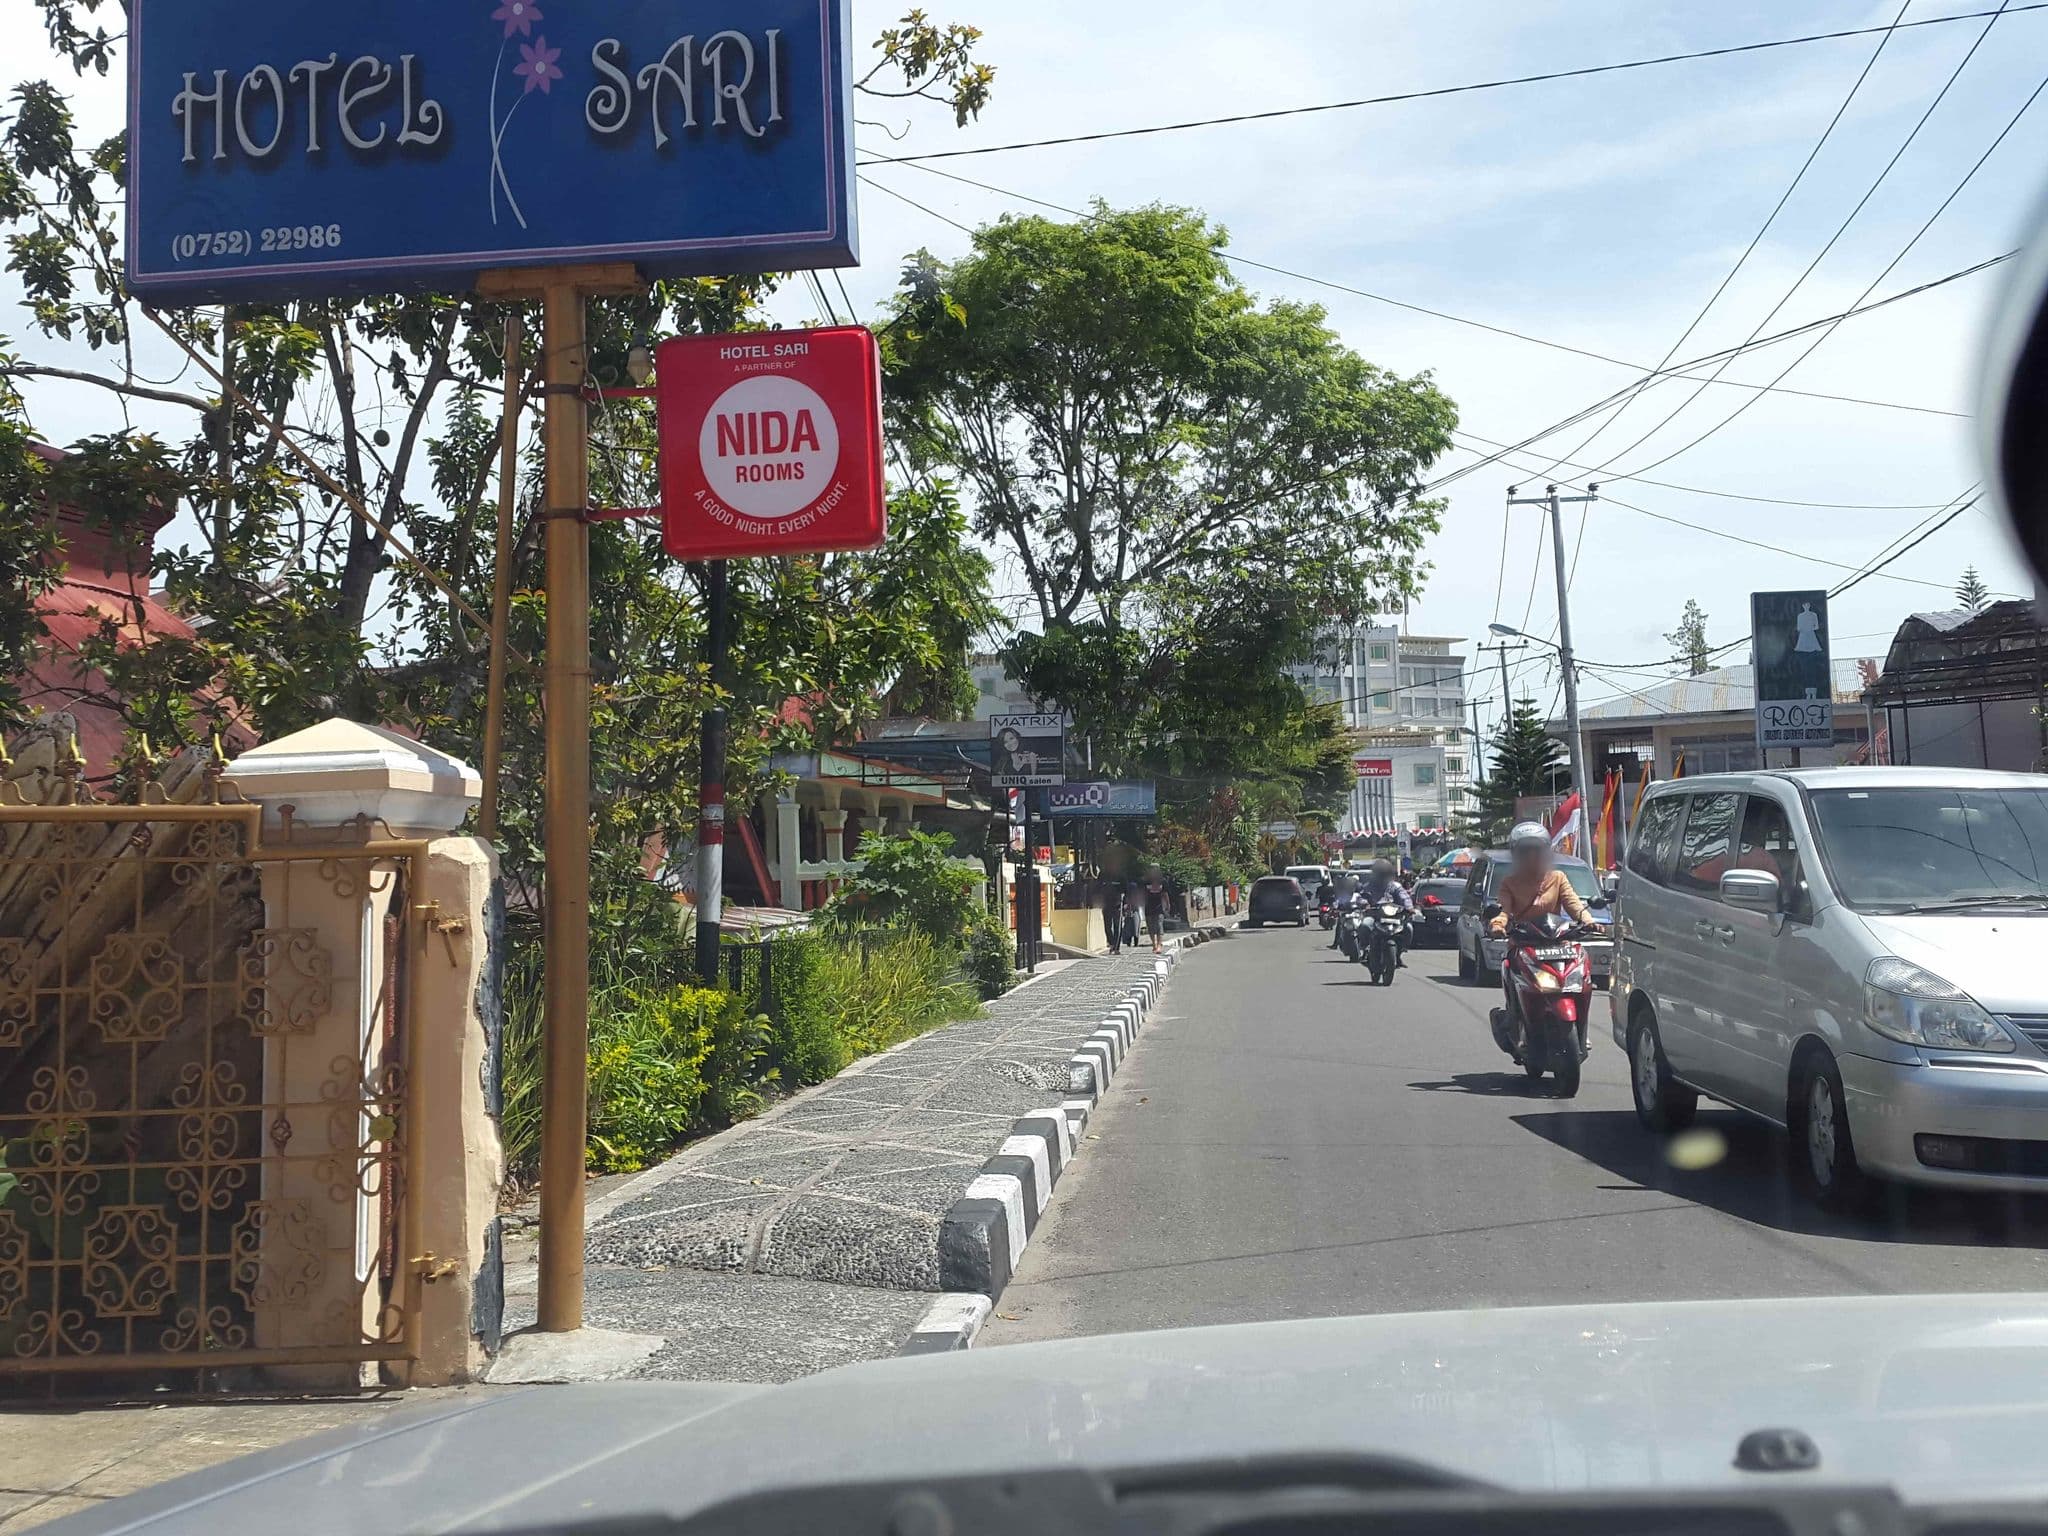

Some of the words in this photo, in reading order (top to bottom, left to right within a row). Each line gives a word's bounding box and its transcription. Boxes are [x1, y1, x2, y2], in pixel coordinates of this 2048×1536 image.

[172, 52, 443, 163] HOTEL
[585, 28, 782, 150] SARI
[171, 229, 252, 261] (0752)
[260, 224, 341, 252] 22986
[720, 345, 770, 360] HOTEL
[774, 342, 809, 356] SARI
[734, 364, 740, 373] A
[741, 362, 782, 372] PARTNER
[784, 360, 797, 369] OF
[716, 408, 821, 457] NIDA
[736, 461, 805, 483] ROOMS
[694, 489, 706, 501] A
[702, 498, 734, 526] GOOD
[735, 517, 776, 535] NIGHT.
[778, 511, 817, 535] EVERY
[815, 480, 849, 517] NIGHT.
[993, 715, 1059, 728] MATRIX
[1001, 776, 1027, 785] UNIQ
[1029, 777, 1052, 785] salon
